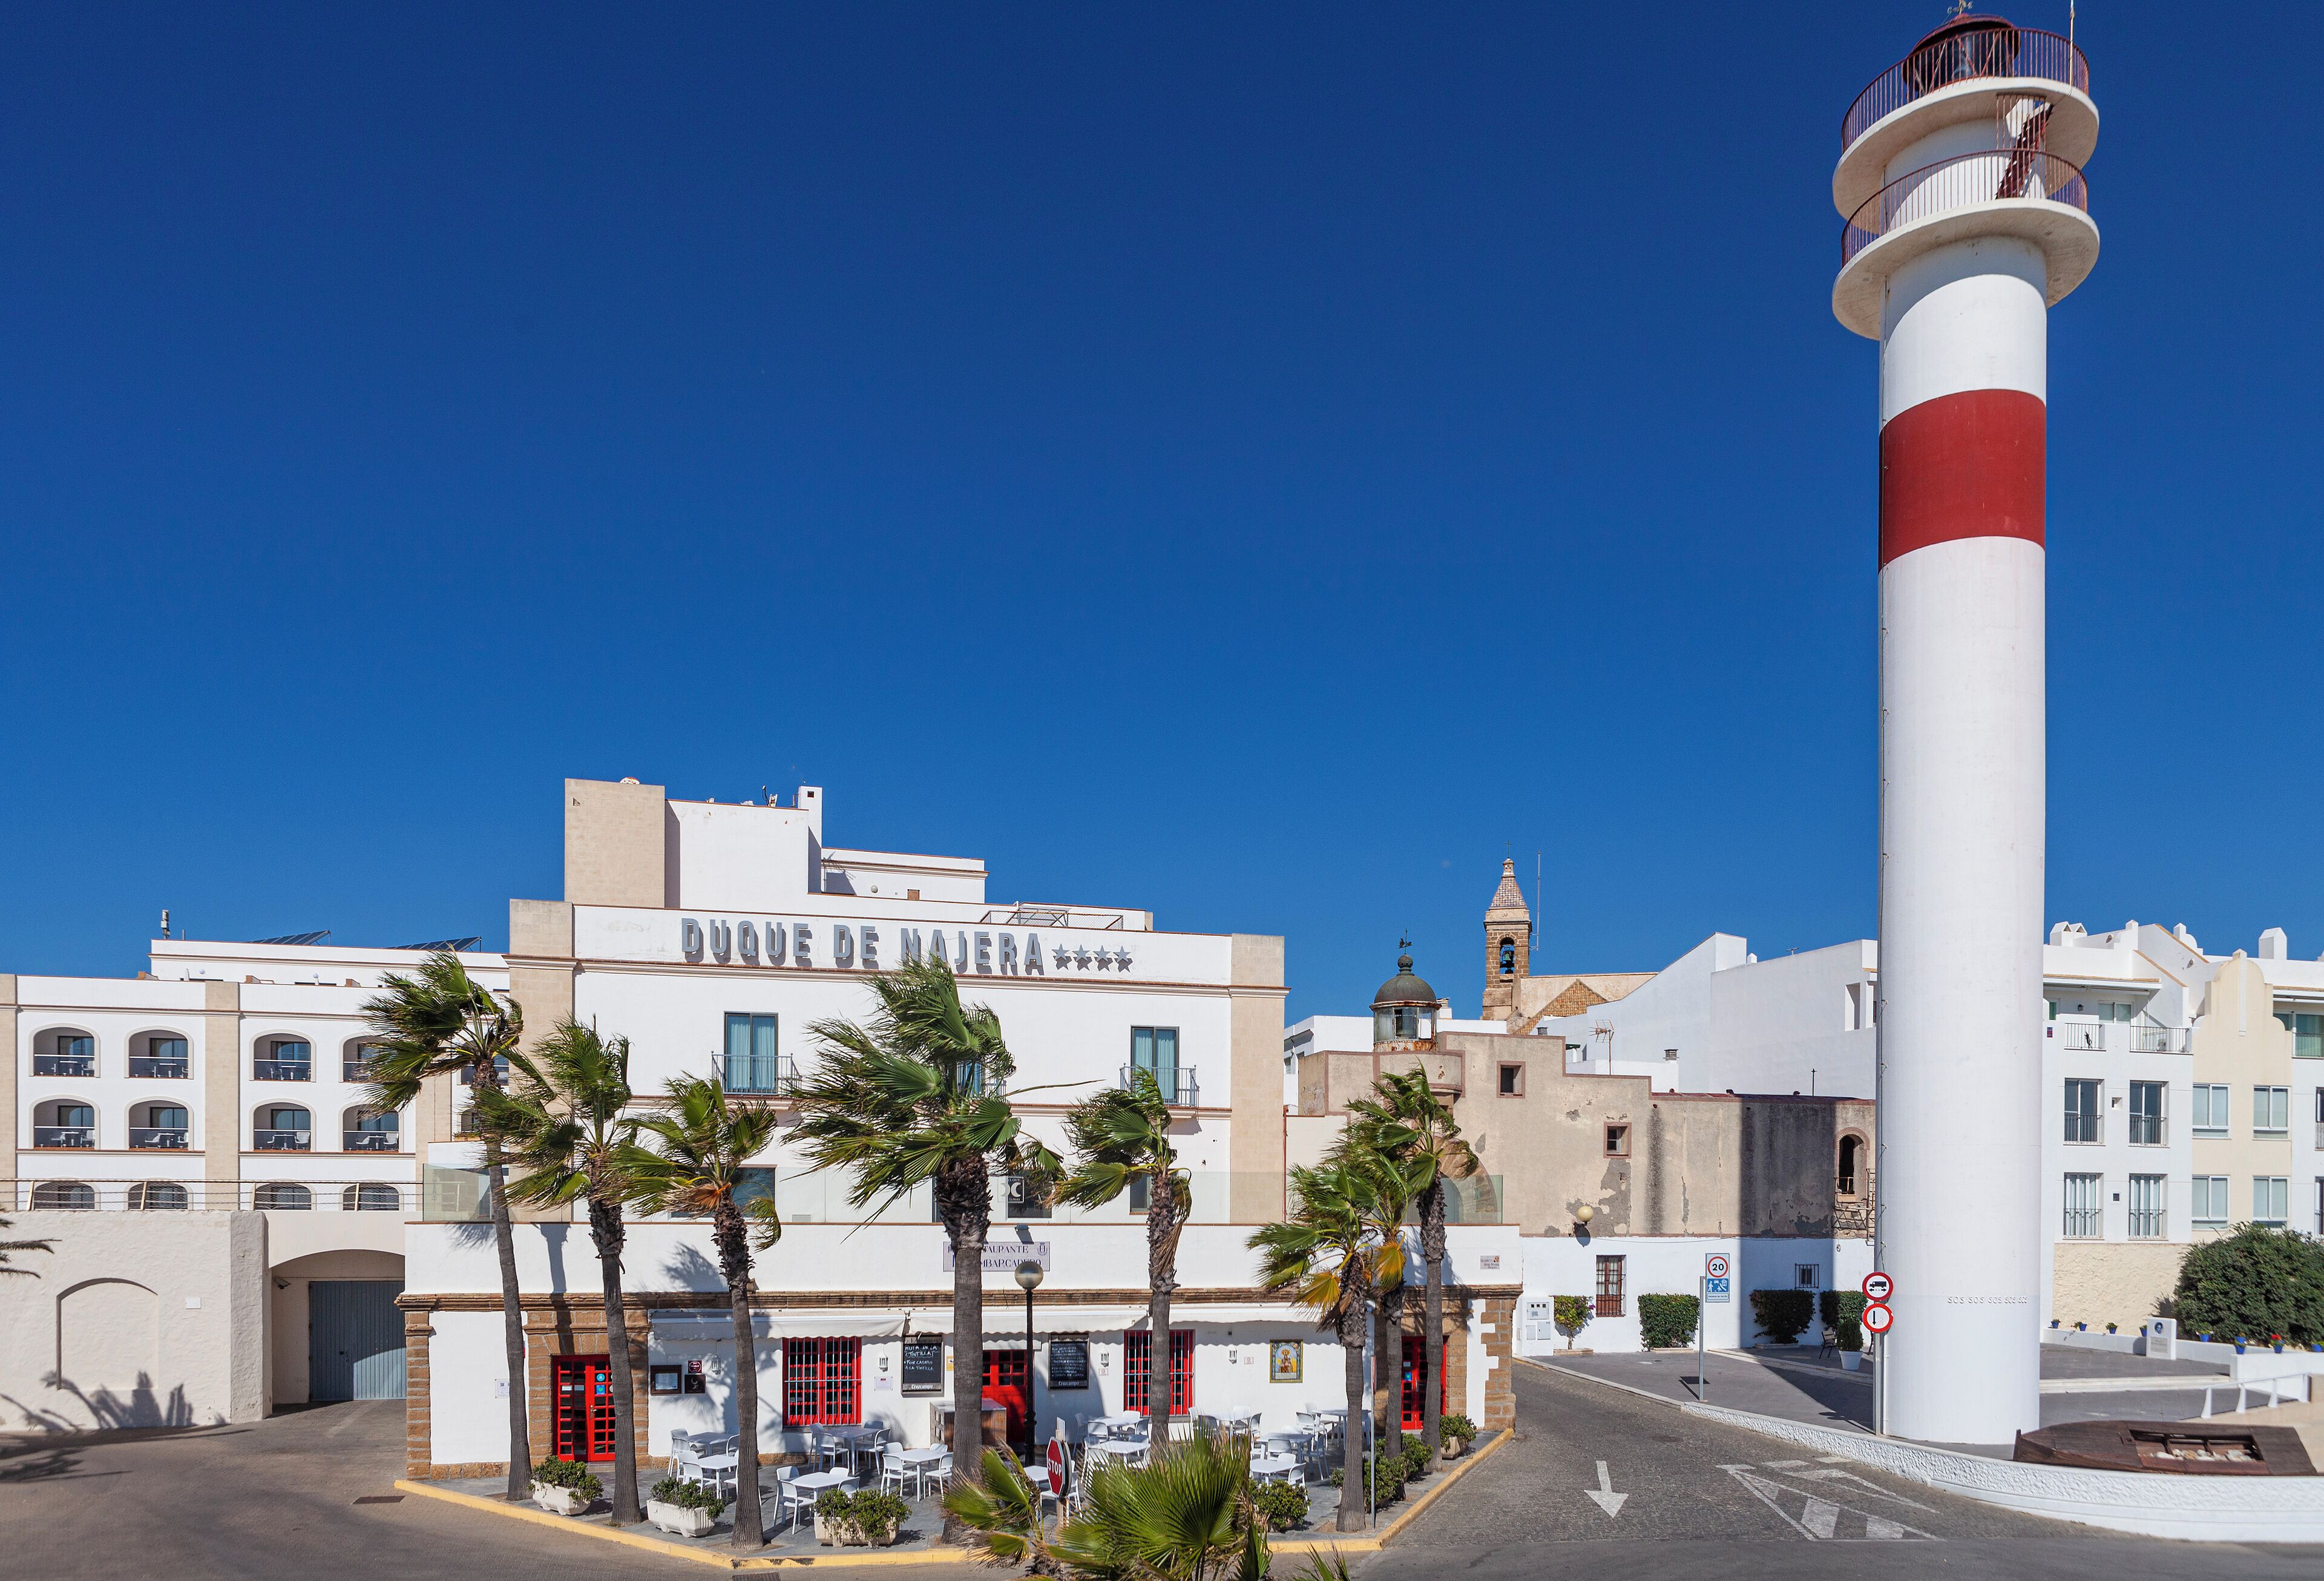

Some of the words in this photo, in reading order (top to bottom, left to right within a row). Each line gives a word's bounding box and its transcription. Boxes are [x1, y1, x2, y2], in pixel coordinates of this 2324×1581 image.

[681, 918, 809, 957] DUQUE
[833, 924, 876, 959] DE
[901, 928, 1043, 965] NAJERA
[1048, 1458, 1062, 1477] STOP
